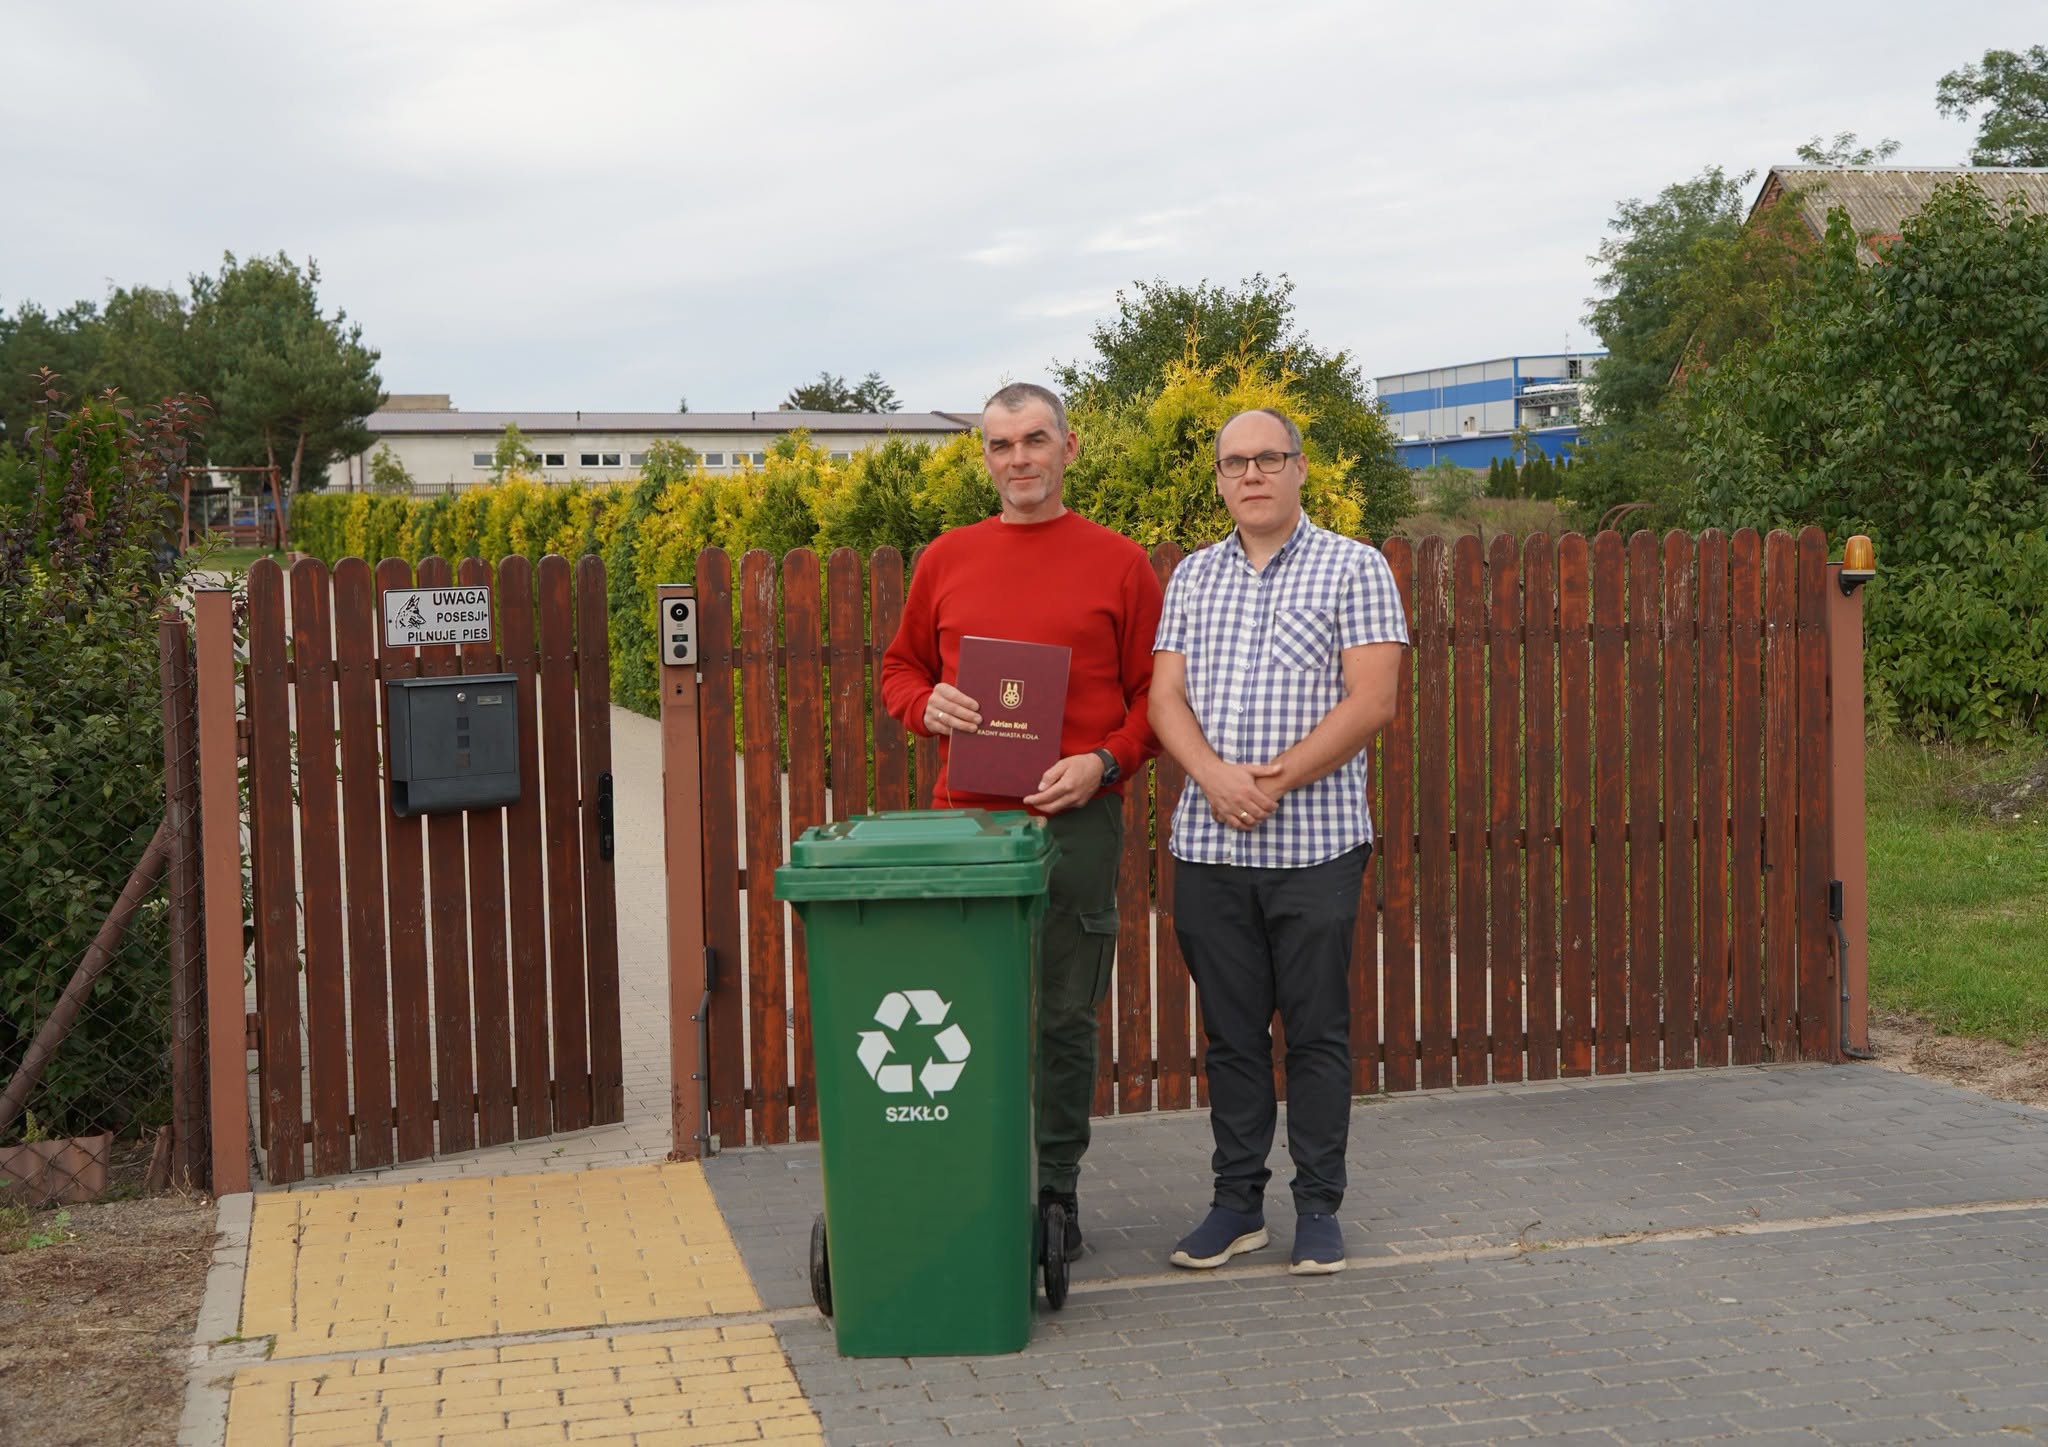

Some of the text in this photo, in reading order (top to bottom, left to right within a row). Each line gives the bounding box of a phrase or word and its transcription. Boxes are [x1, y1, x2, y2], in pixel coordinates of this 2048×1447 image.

[432, 591, 486, 605] UWAGA
[436, 611, 484, 623] POSESJI
[407, 628, 488, 642] PILNUJE PIES
[990, 719, 1028, 730] Adrian Król
[885, 1105, 949, 1122] SZKŁO
